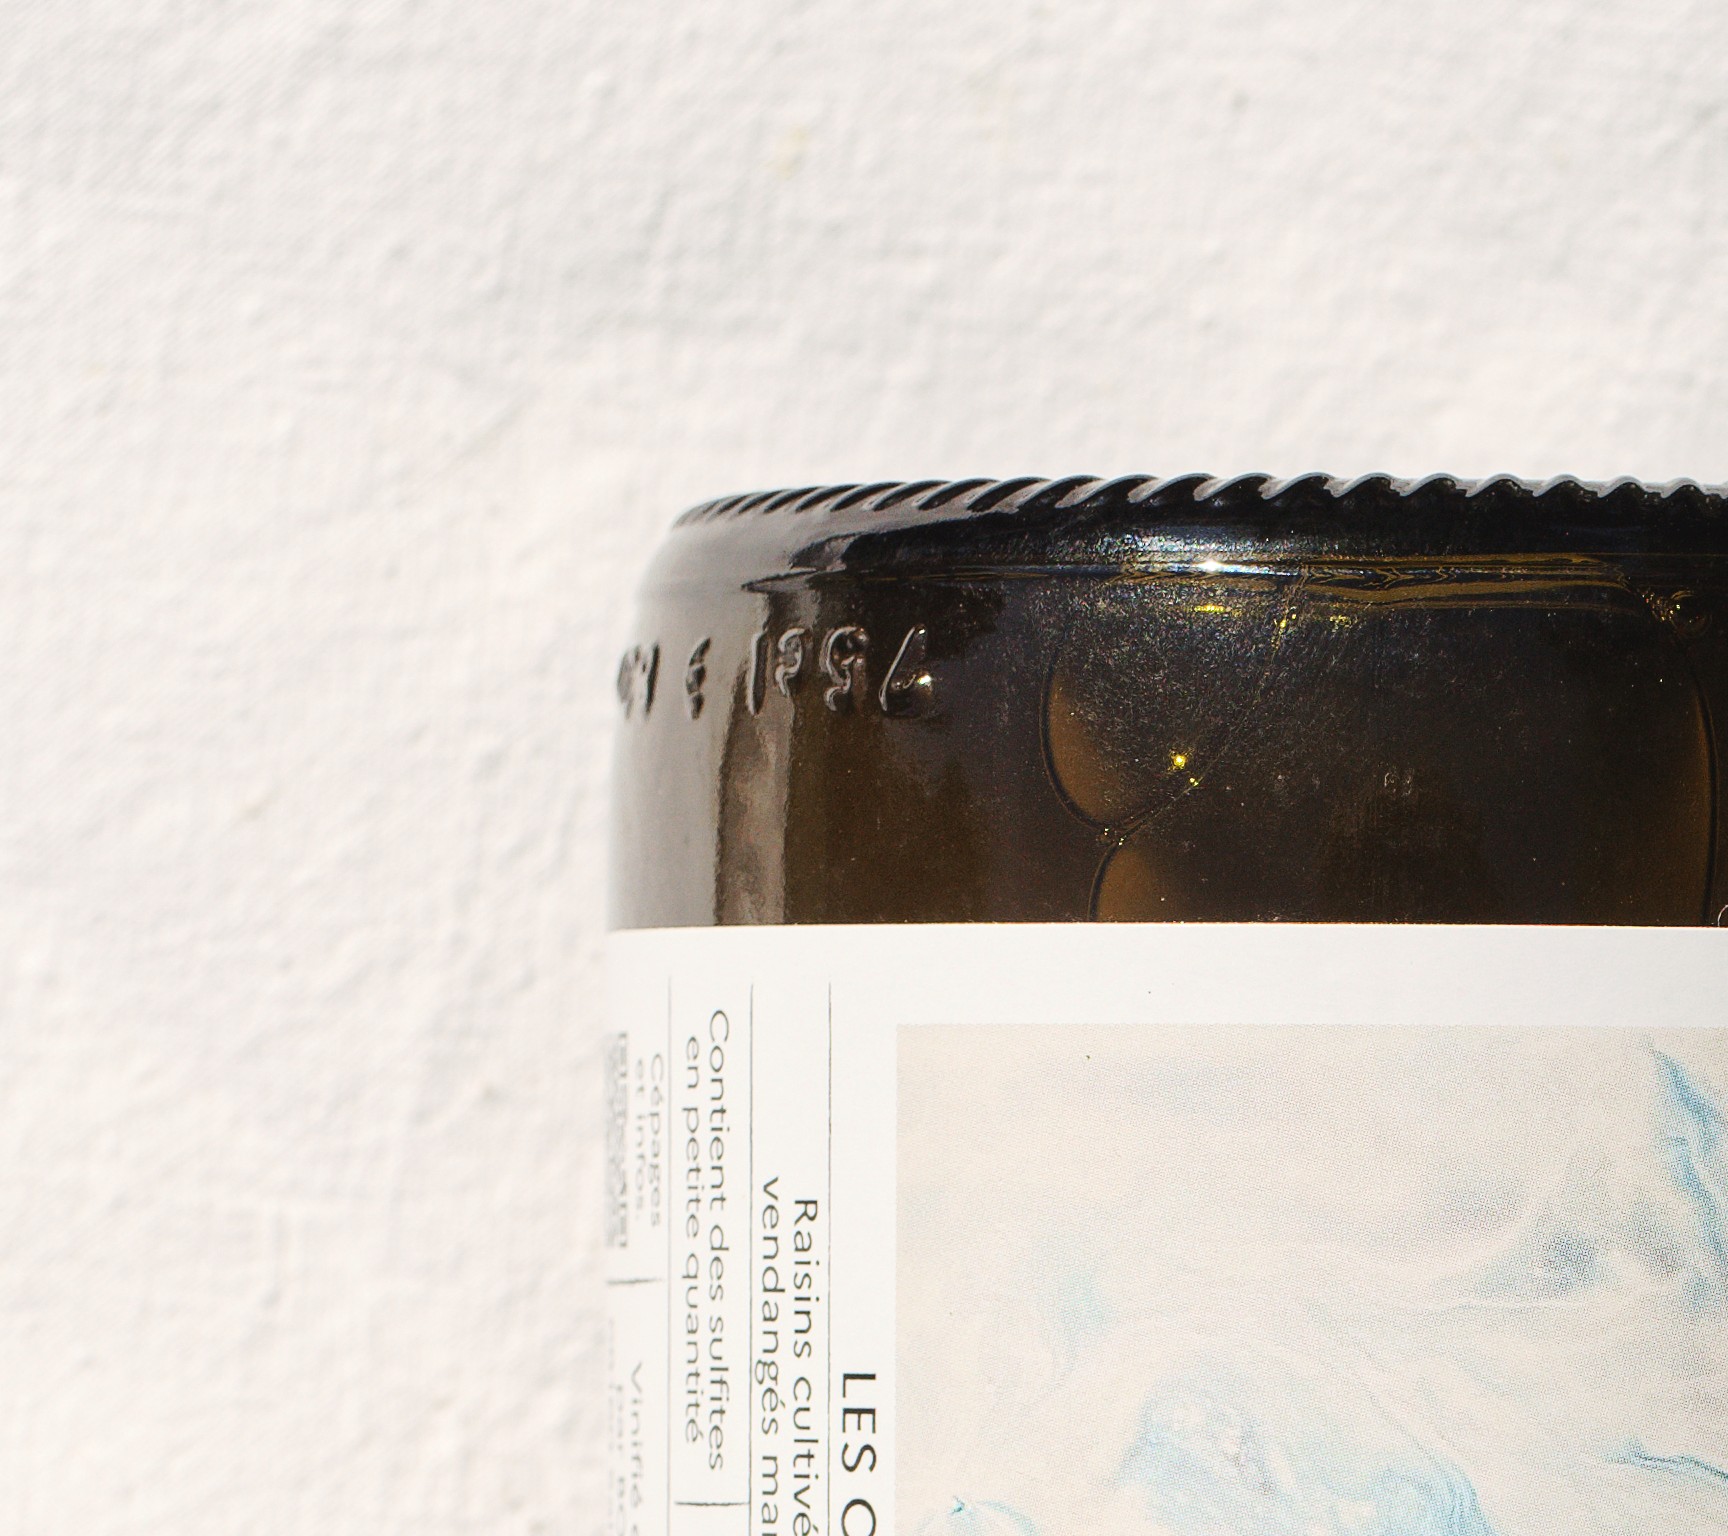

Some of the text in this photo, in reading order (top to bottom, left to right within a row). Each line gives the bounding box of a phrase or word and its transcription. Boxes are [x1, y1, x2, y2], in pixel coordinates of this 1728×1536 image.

[647, 1051, 666, 1228] Cépages
[681, 1035, 705, 1443] en petite quantité
[708, 1009, 731, 1471] Contient des sulfites
[754, 1176, 786, 1436] vendangés
[793, 1199, 820, 1359] Raisins
[629, 1360, 643, 1510] Vinifié
[841, 1372, 877, 1473] LES
